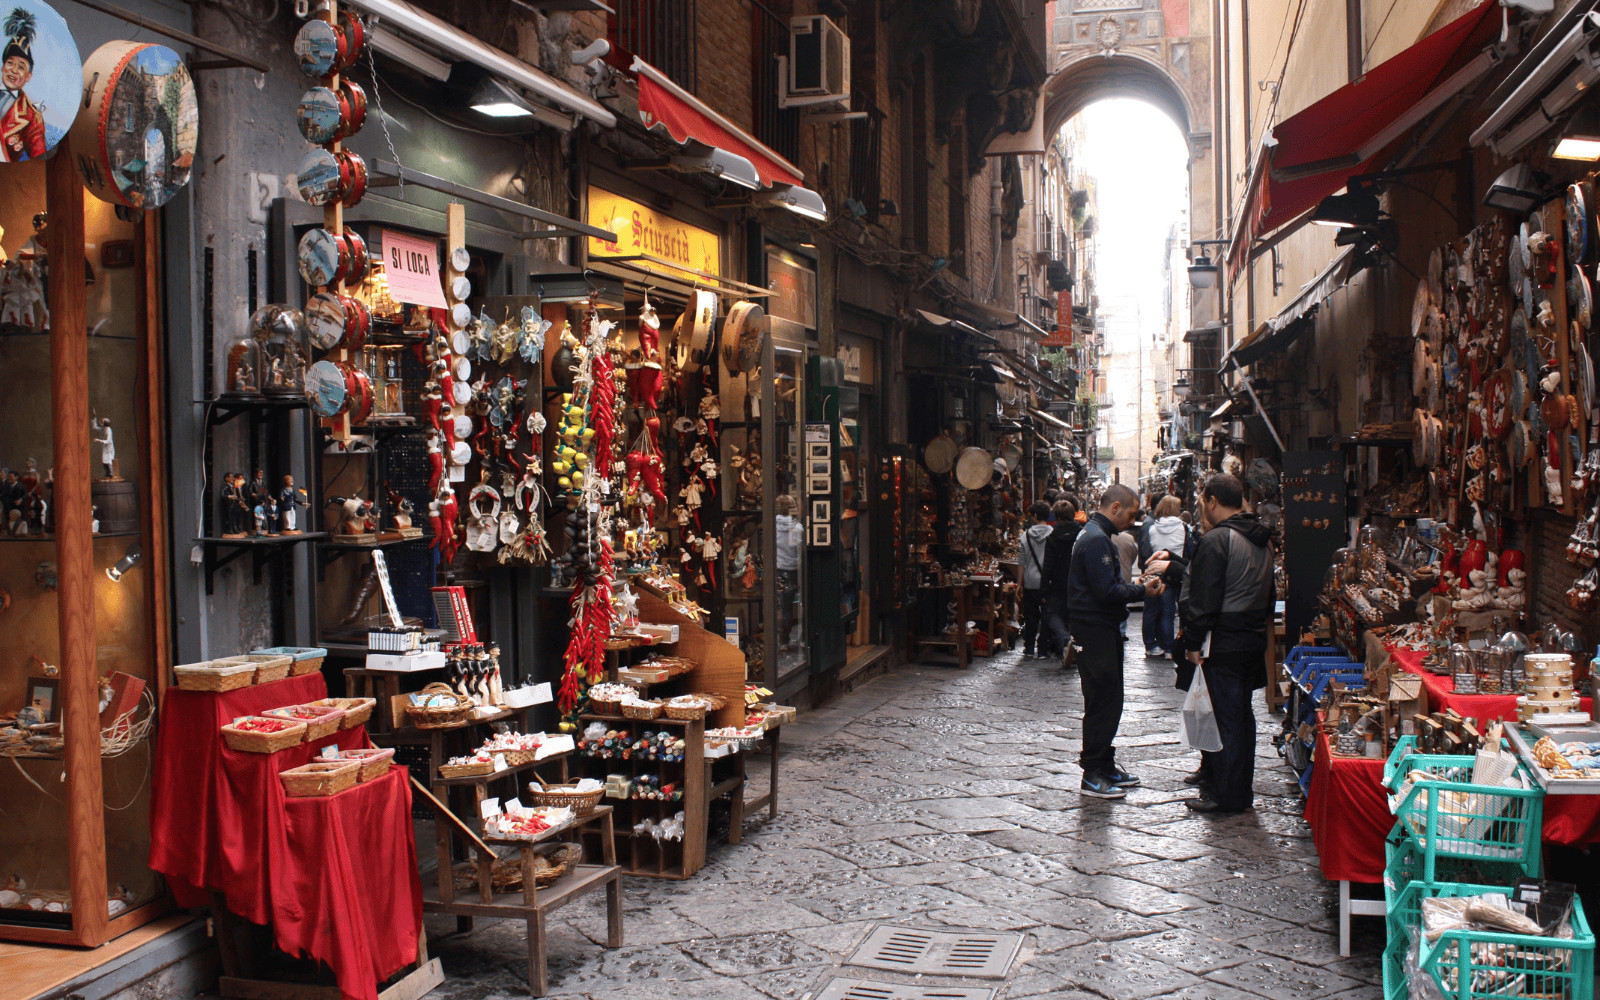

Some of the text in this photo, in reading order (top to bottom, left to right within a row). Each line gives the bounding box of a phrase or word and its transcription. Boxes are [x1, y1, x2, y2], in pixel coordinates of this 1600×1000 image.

[632, 210, 689, 264] Sciuscià
[391, 247, 430, 276] SI LOCA
[452, 593, 460, 611] GIOCO
[462, 597, 474, 633] NAPOLETANE
[459, 620, 467, 638] CARTE
